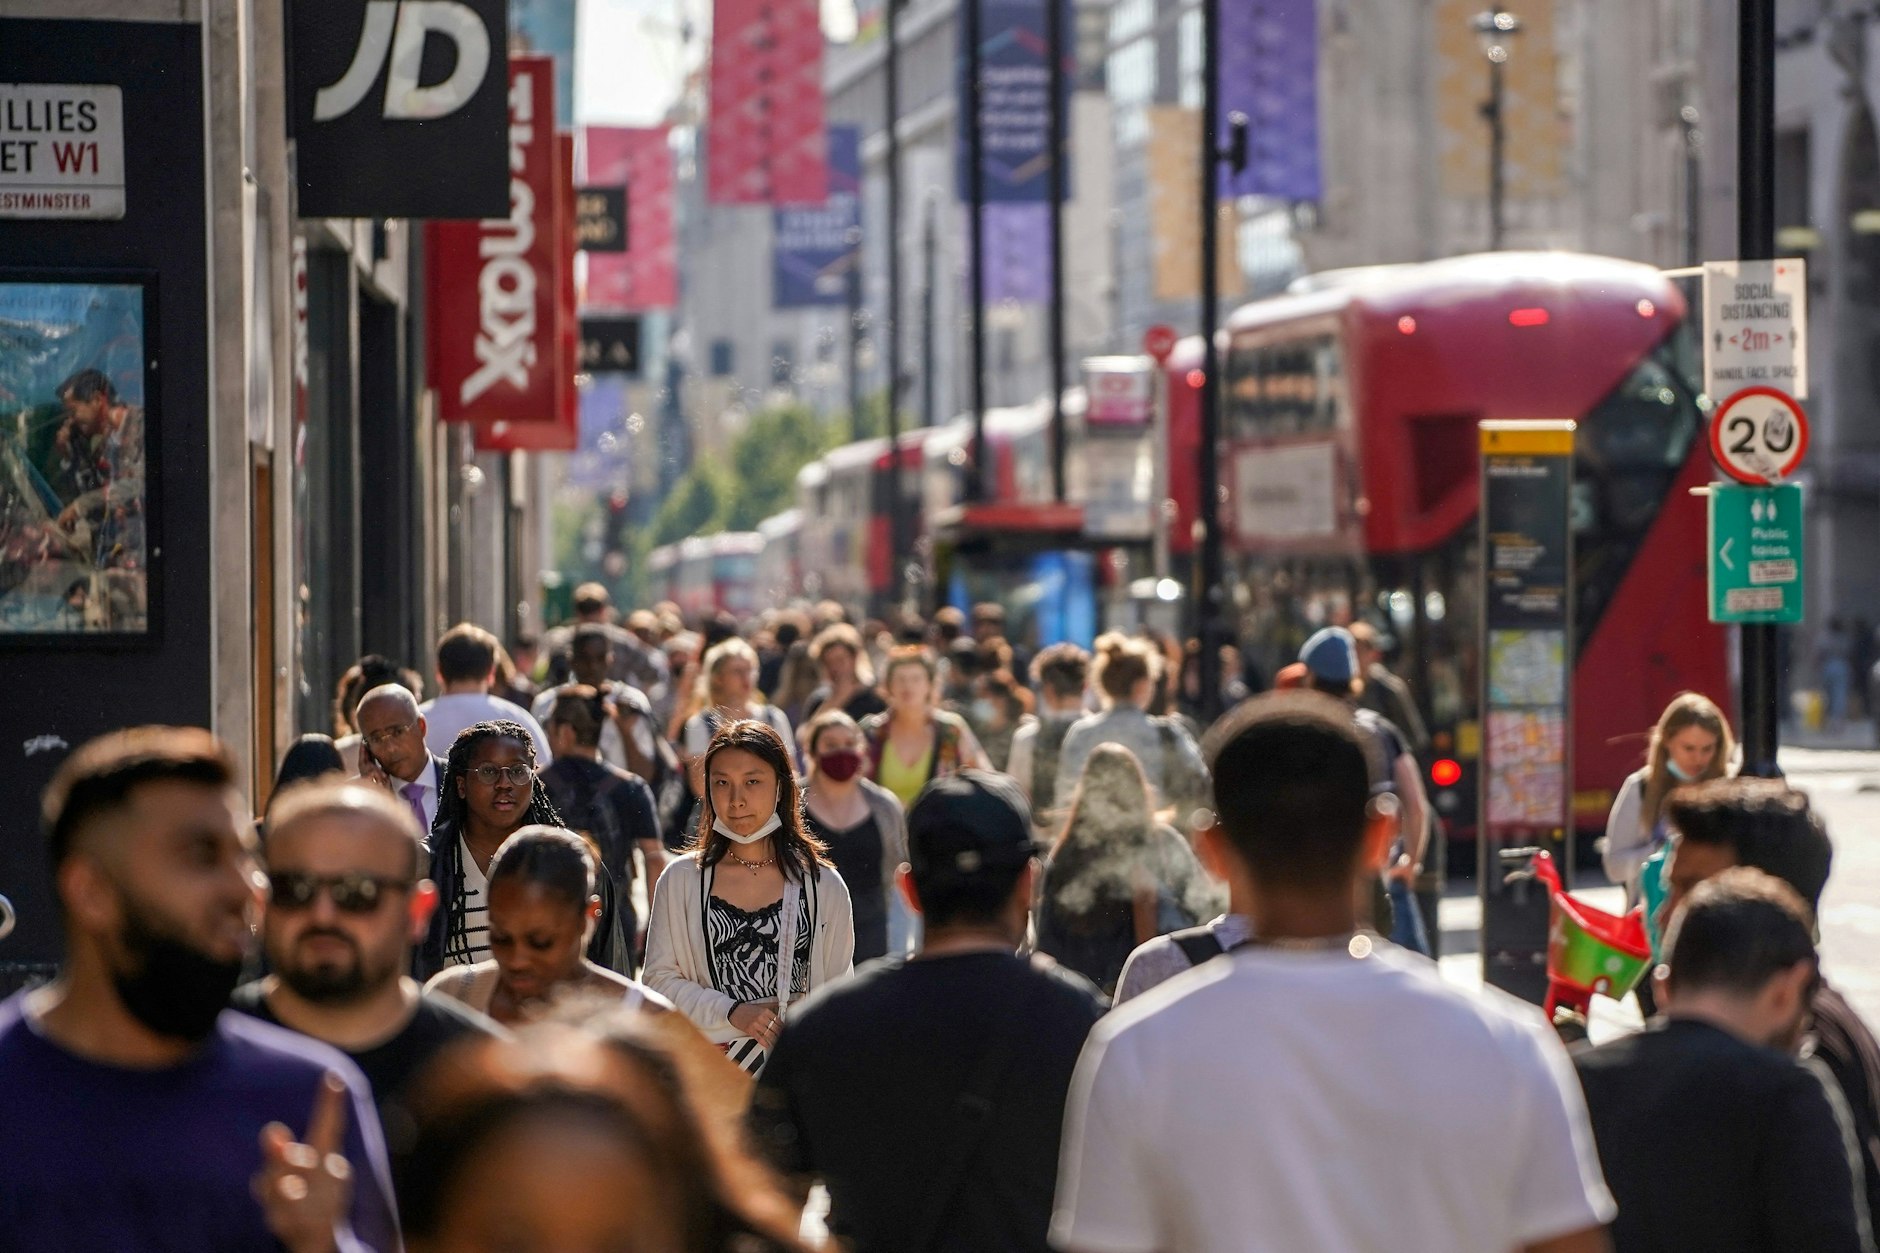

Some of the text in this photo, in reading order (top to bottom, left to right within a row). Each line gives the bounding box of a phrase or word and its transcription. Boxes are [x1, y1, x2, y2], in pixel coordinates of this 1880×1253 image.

[312, 0, 491, 121] JD
[0, 99, 97, 133] LLIES
[53, 141, 98, 174] W1
[1734, 283, 1775, 300] SOCIAL
[1721, 302, 1790, 320] DISTANCING
[1741, 327, 1770, 352] 2m
[1728, 416, 1793, 454] 20
[1751, 526, 1789, 540] Public
